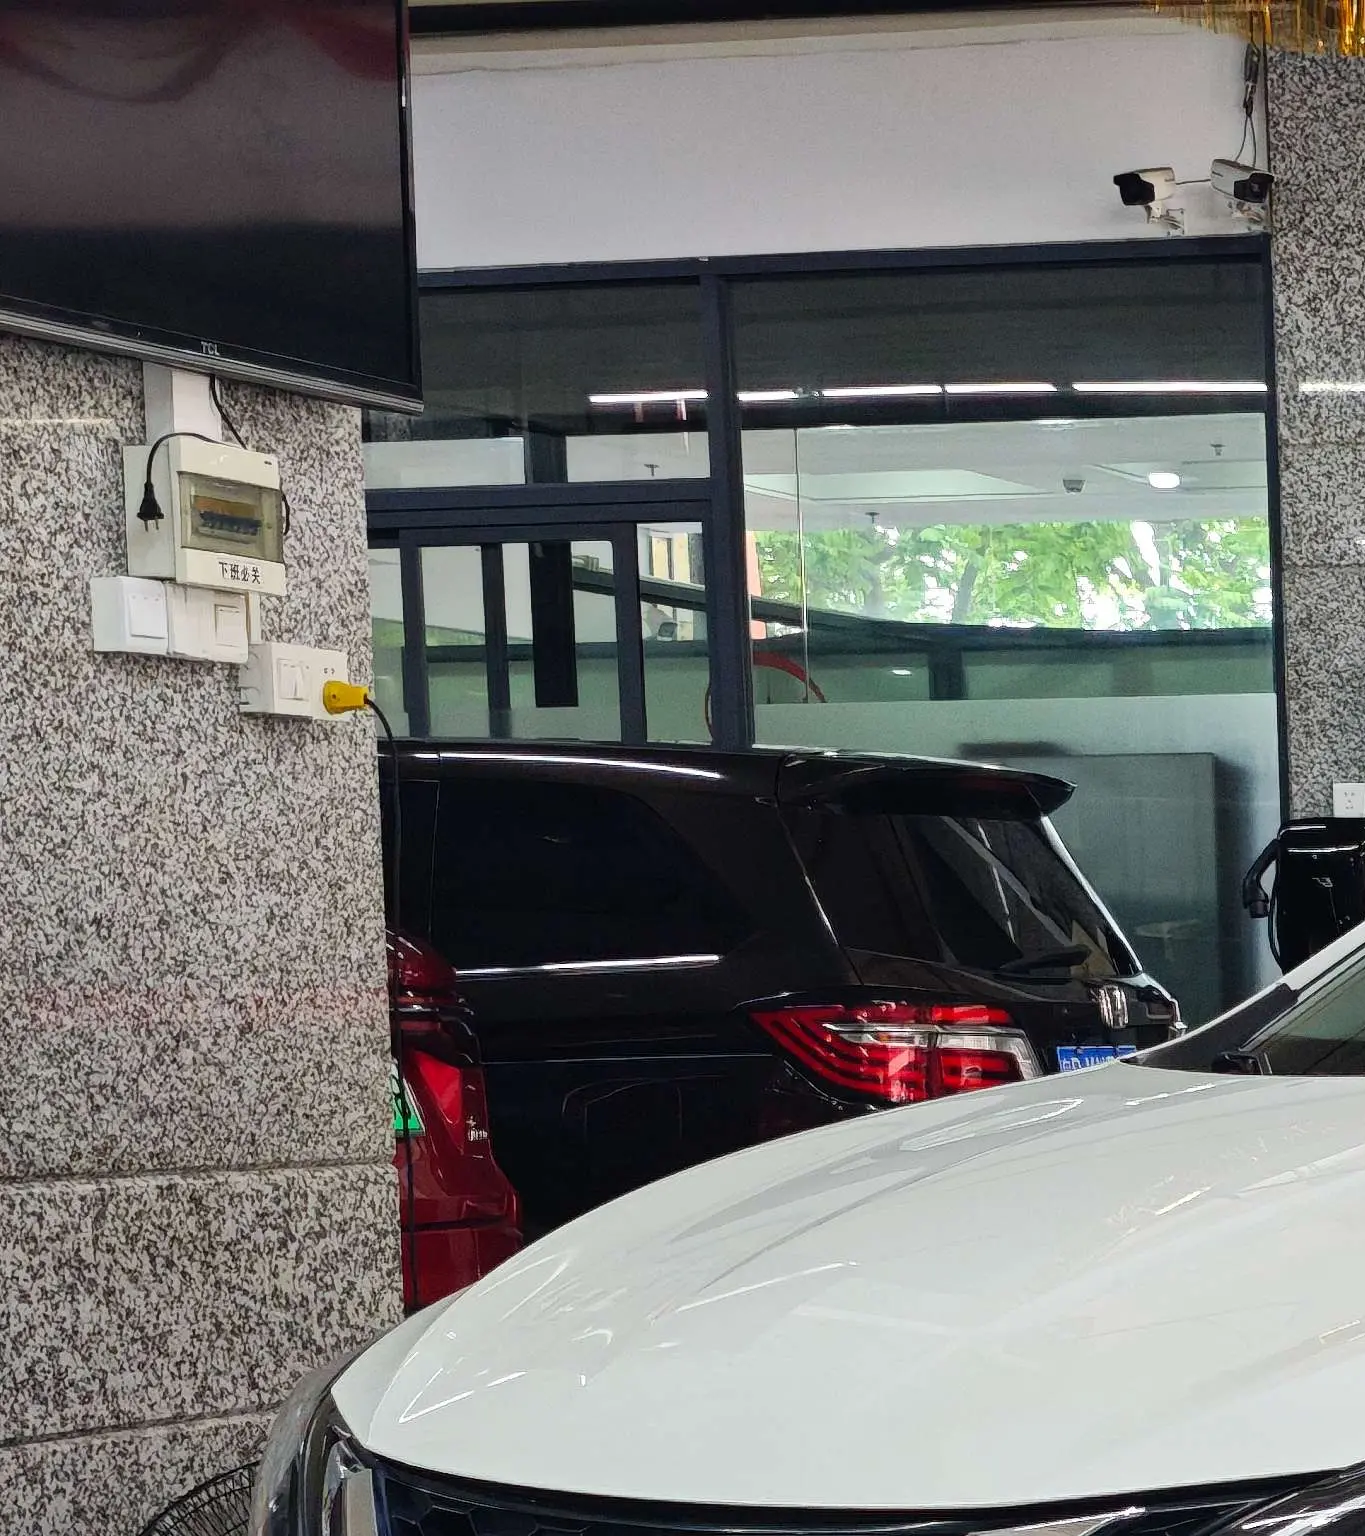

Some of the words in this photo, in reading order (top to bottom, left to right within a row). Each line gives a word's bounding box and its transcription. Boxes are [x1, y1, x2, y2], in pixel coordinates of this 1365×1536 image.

[200, 341, 220, 356] TCL
[218, 561, 261, 585] 下班必关
